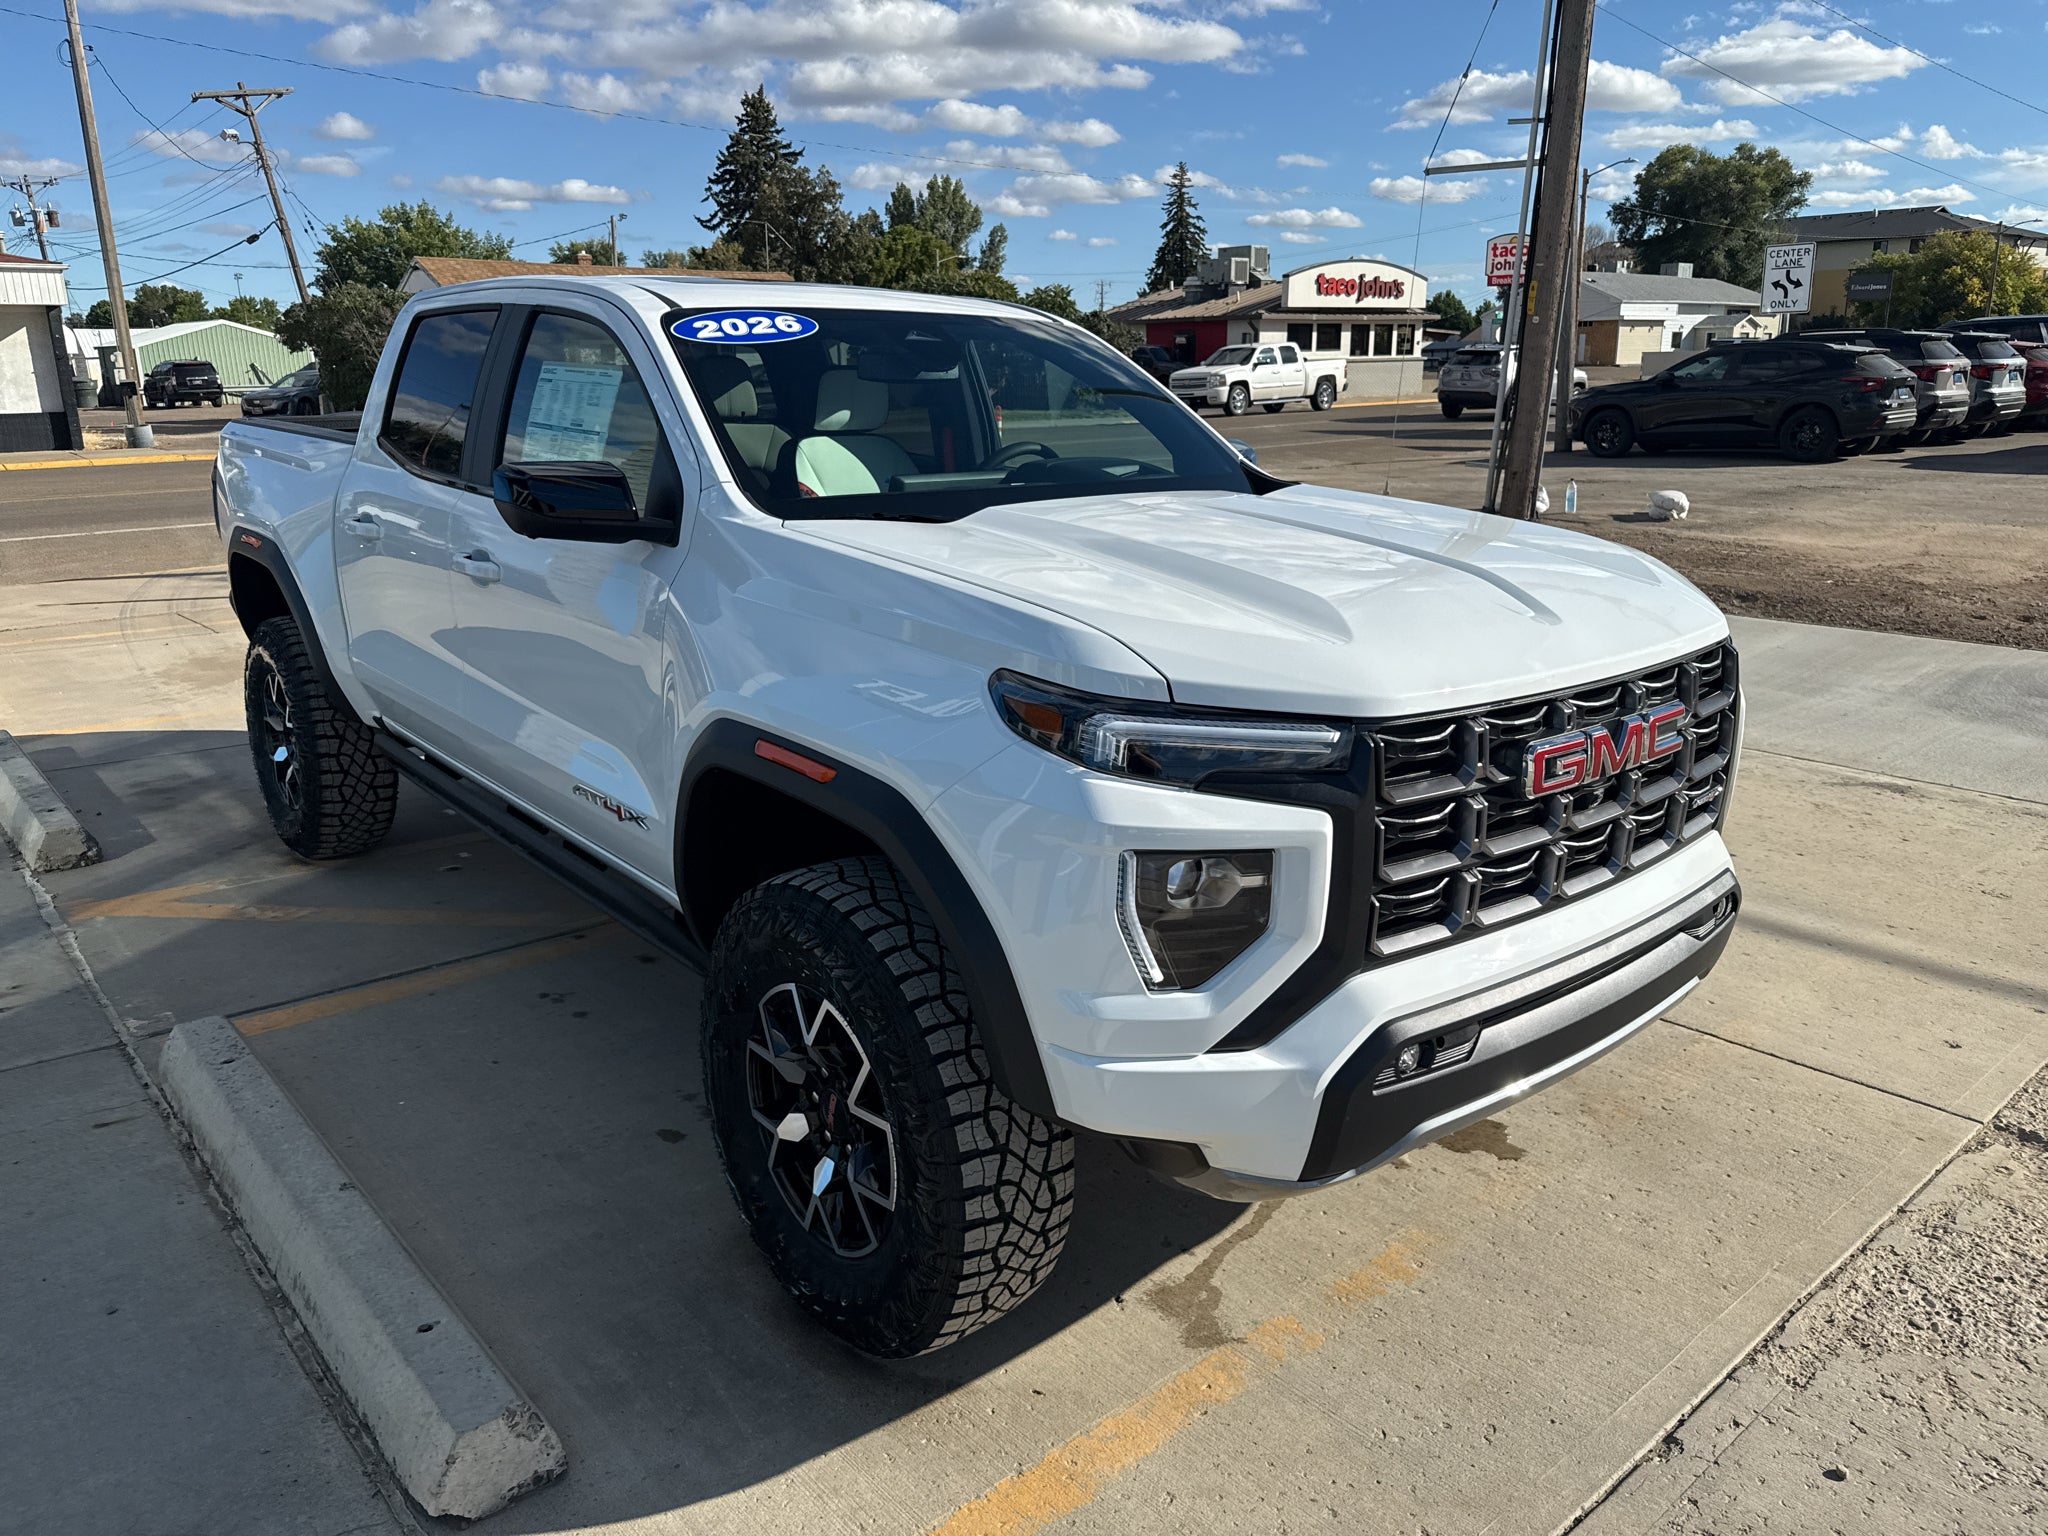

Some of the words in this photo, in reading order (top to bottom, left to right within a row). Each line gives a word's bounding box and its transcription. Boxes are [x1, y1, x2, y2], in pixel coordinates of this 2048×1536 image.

[1769, 247, 1811, 258] CENTER
[1774, 257, 1803, 267] LANE
[1315, 273, 1357, 296] taco
[1355, 273, 1405, 304] john's
[1770, 299, 1798, 309] ONLY
[692, 315, 802, 338] 2026
[1522, 698, 1686, 800] GMC
[572, 783, 651, 831] AT4X
